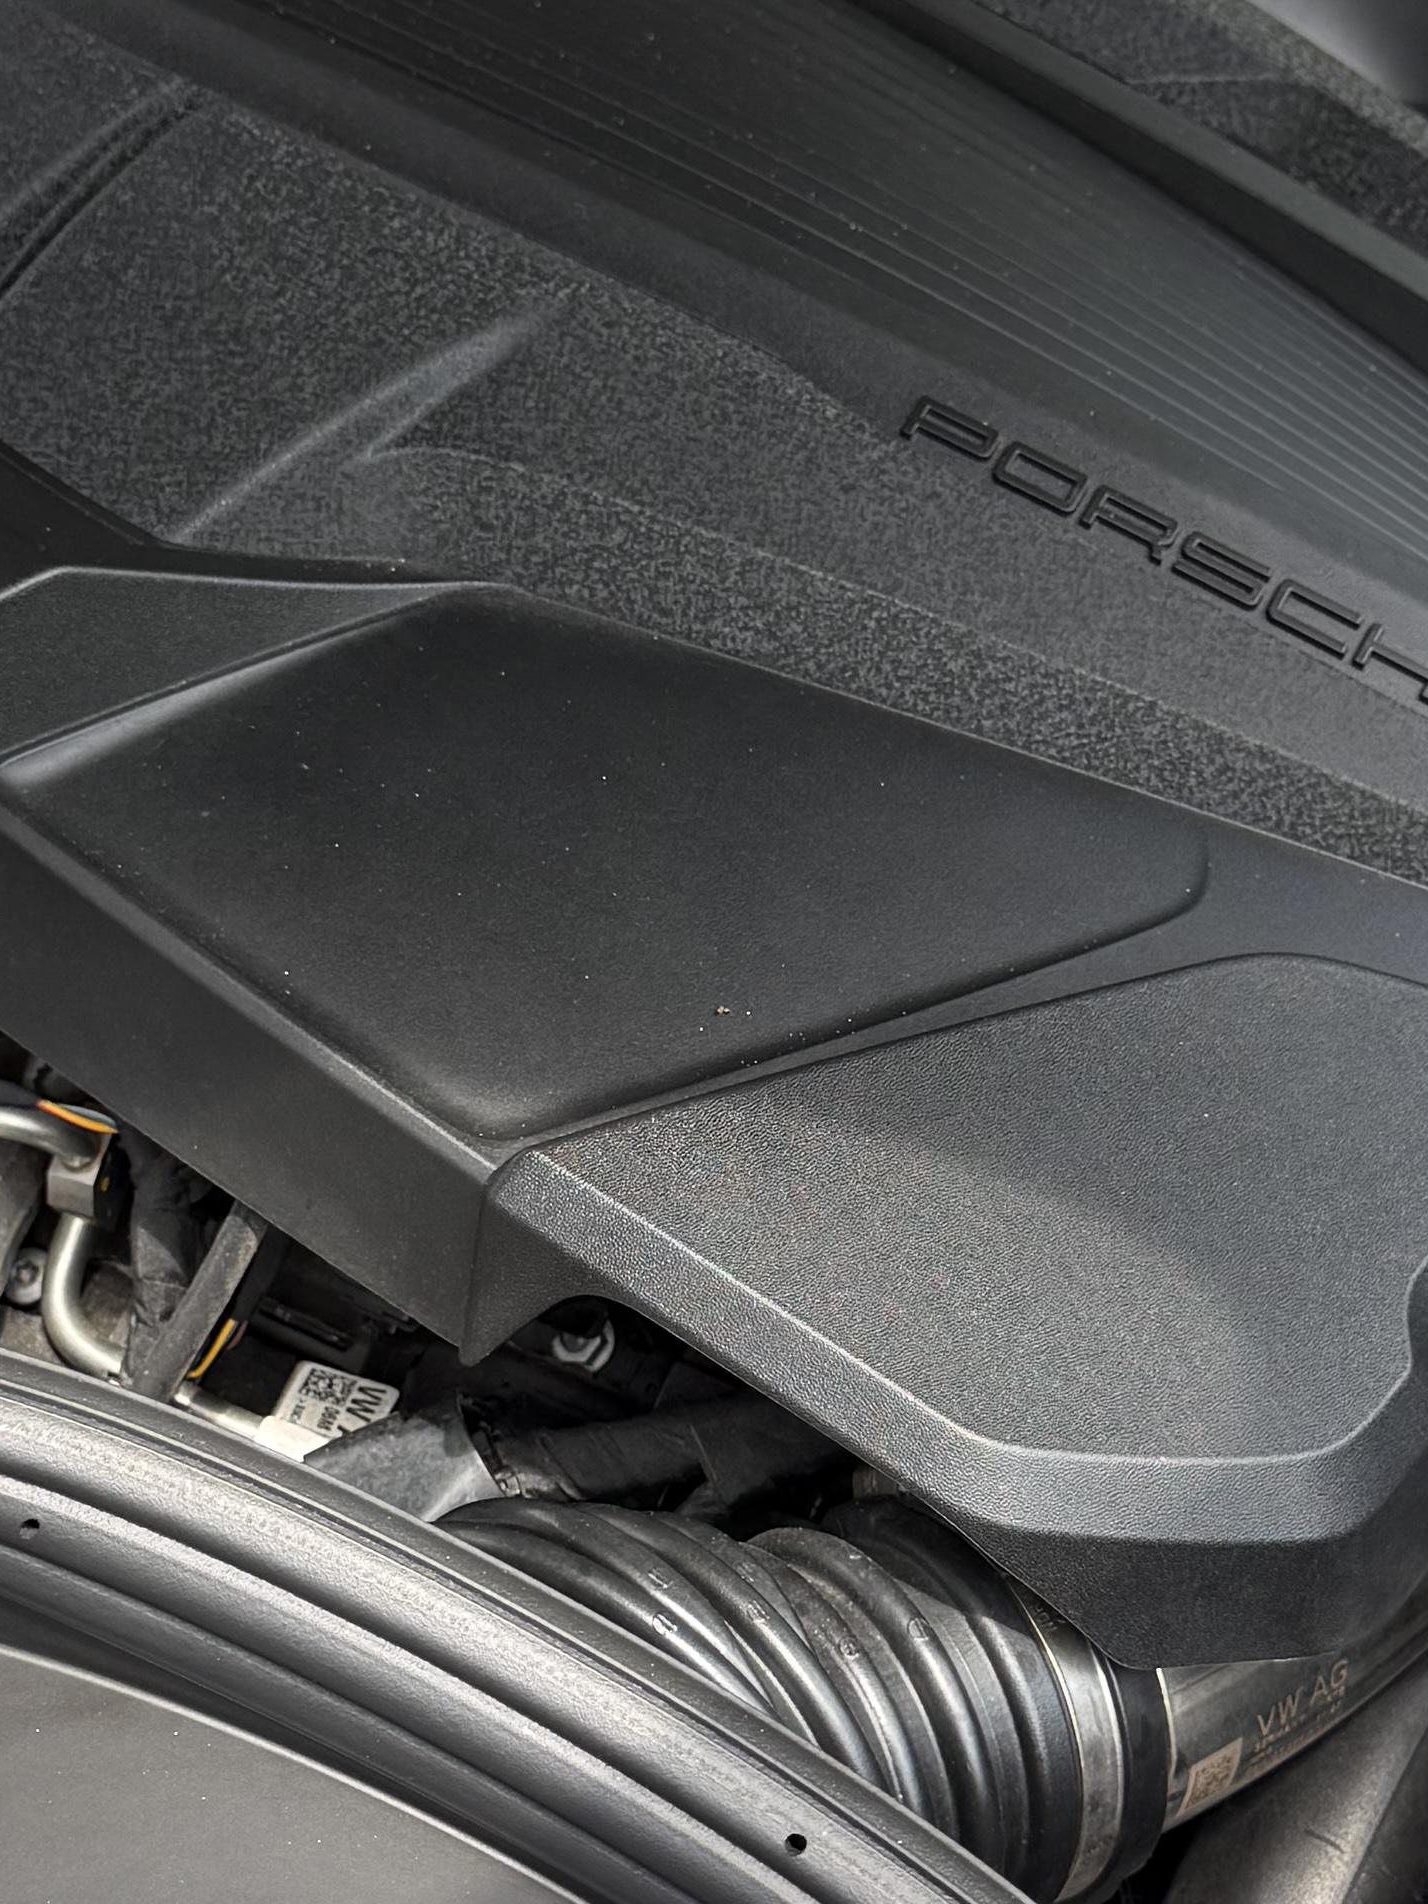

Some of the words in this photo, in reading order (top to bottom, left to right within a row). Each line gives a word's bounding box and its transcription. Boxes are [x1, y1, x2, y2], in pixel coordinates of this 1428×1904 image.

[345, 1385, 387, 1423] VW
[1256, 1685, 1305, 1737] VW
[1309, 1657, 1349, 1705] AG
